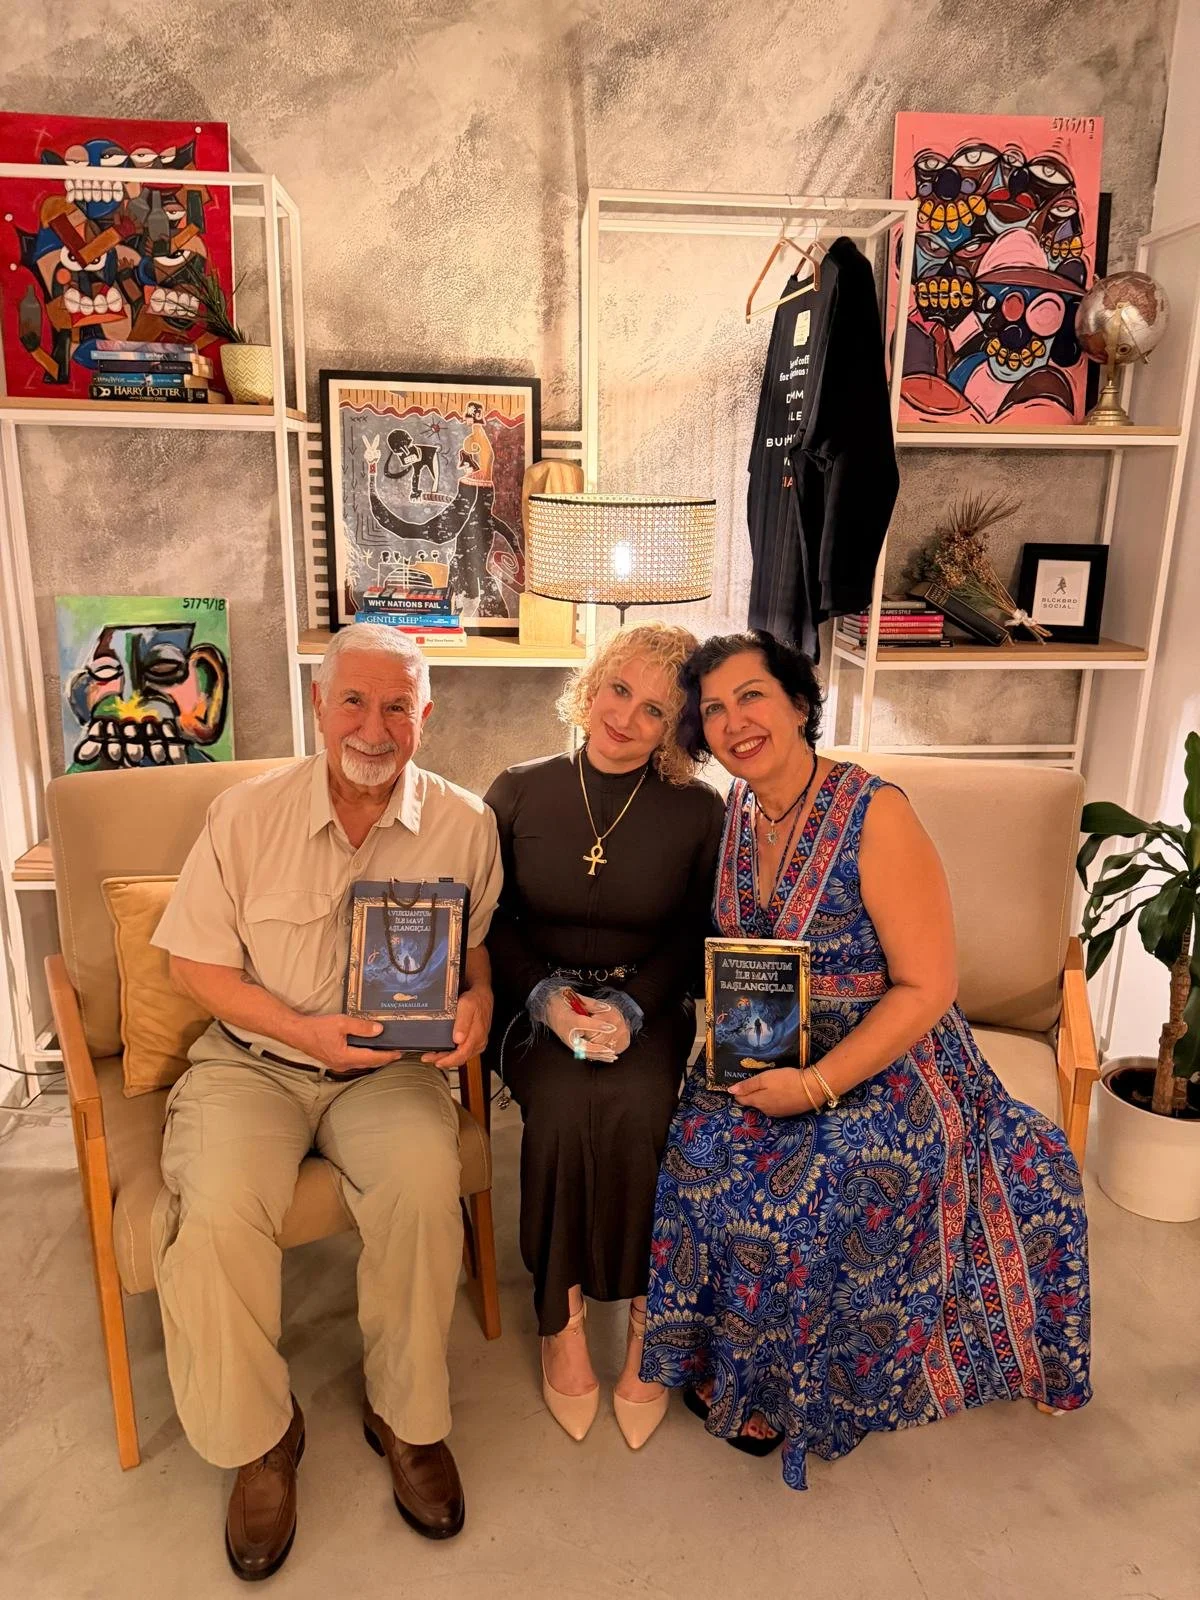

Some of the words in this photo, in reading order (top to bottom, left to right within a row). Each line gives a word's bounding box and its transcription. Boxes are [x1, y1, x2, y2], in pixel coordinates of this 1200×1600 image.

[114, 386, 145, 397] HARRY
[147, 387, 181, 397] POTTER
[183, 597, 226, 611] 5779/18
[368, 599, 386, 607] WHY
[387, 600, 423, 608] NATIONS
[366, 615, 397, 624] GENTLE
[398, 616, 419, 624] SLEEP
[721, 958, 793, 971] AVUKUANTUM
[735, 971, 752, 980] İLE
[752, 971, 779, 981] MAVİ
[720, 981, 795, 993] BAŞLANGIÇLAR
